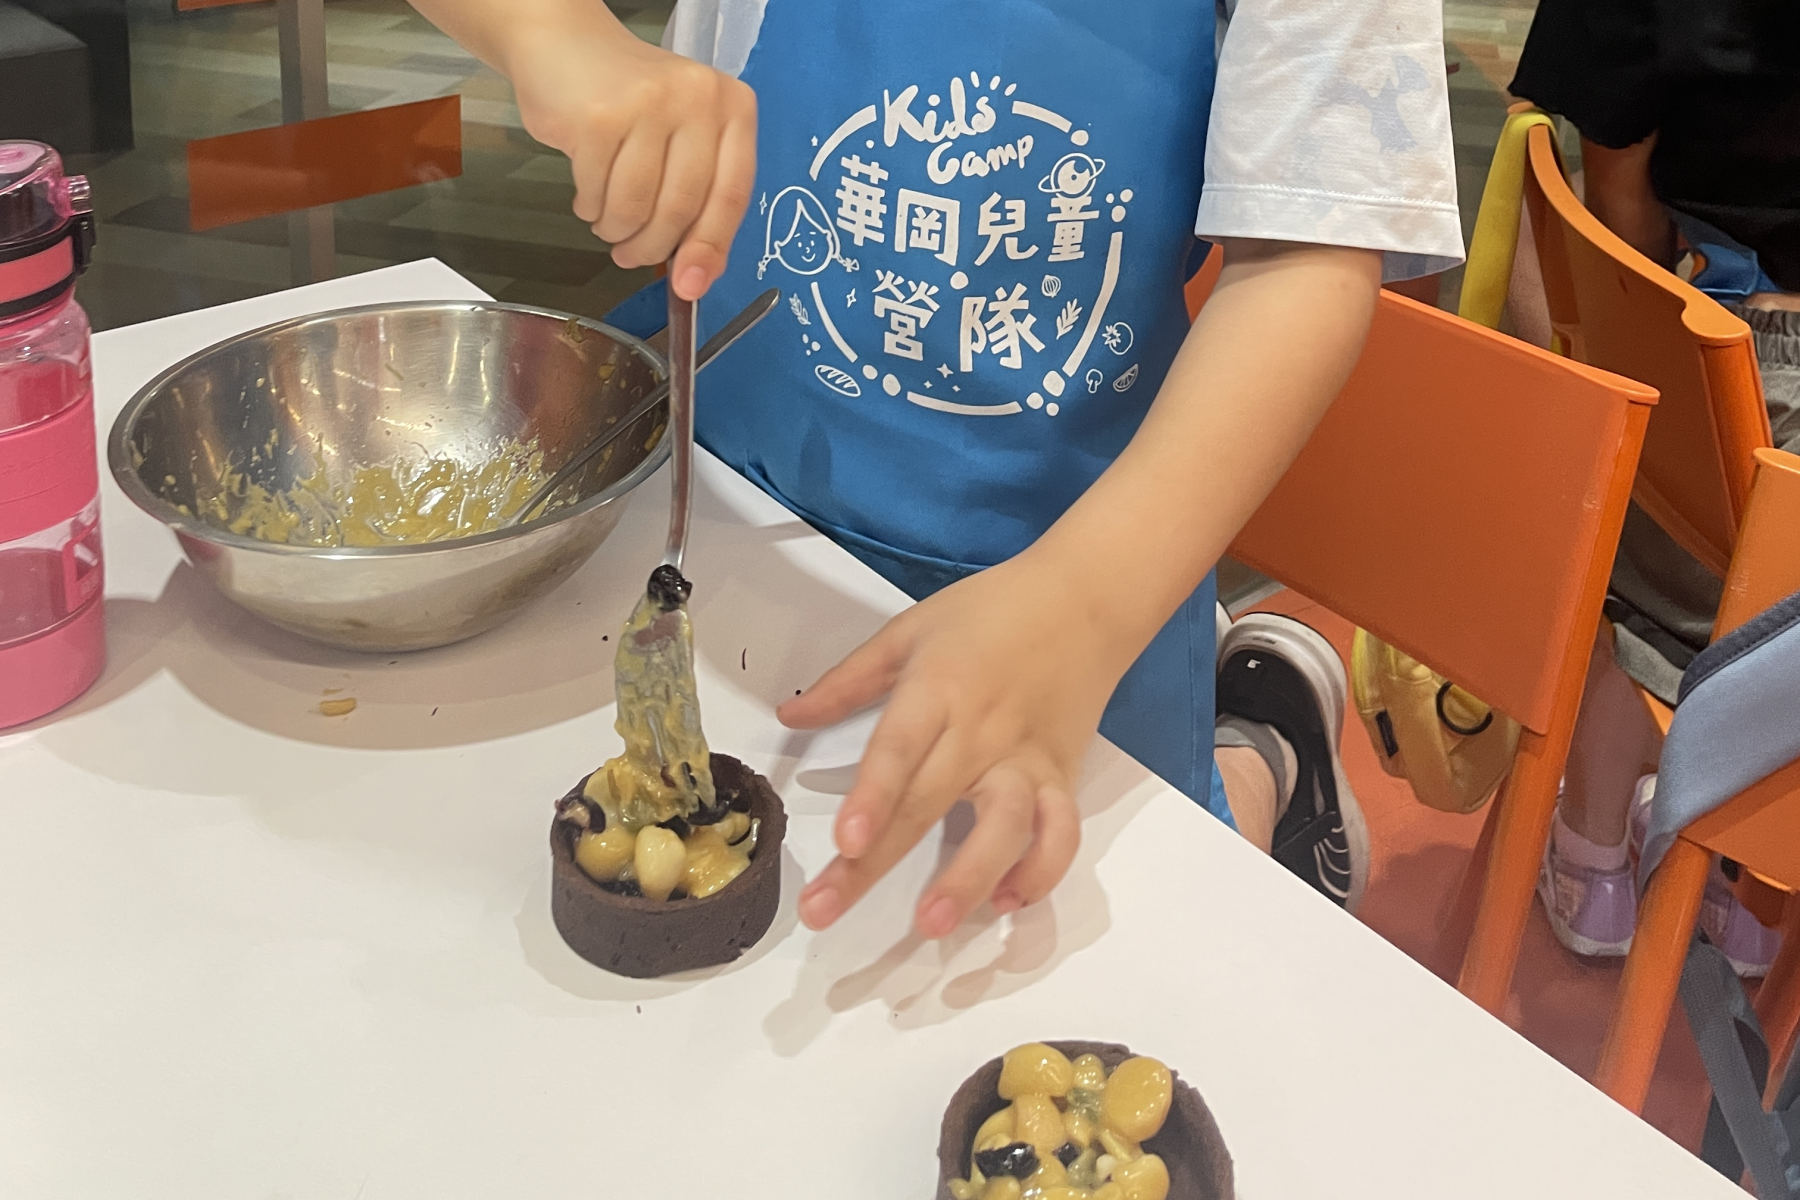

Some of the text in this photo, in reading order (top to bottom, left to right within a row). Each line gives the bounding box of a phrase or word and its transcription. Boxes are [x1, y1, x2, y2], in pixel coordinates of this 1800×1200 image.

[884, 77, 996, 147] Kids
[926, 135, 1034, 184] Camp
[836, 154, 1100, 265] 華岡兒童
[872, 270, 1045, 372] 營隊
